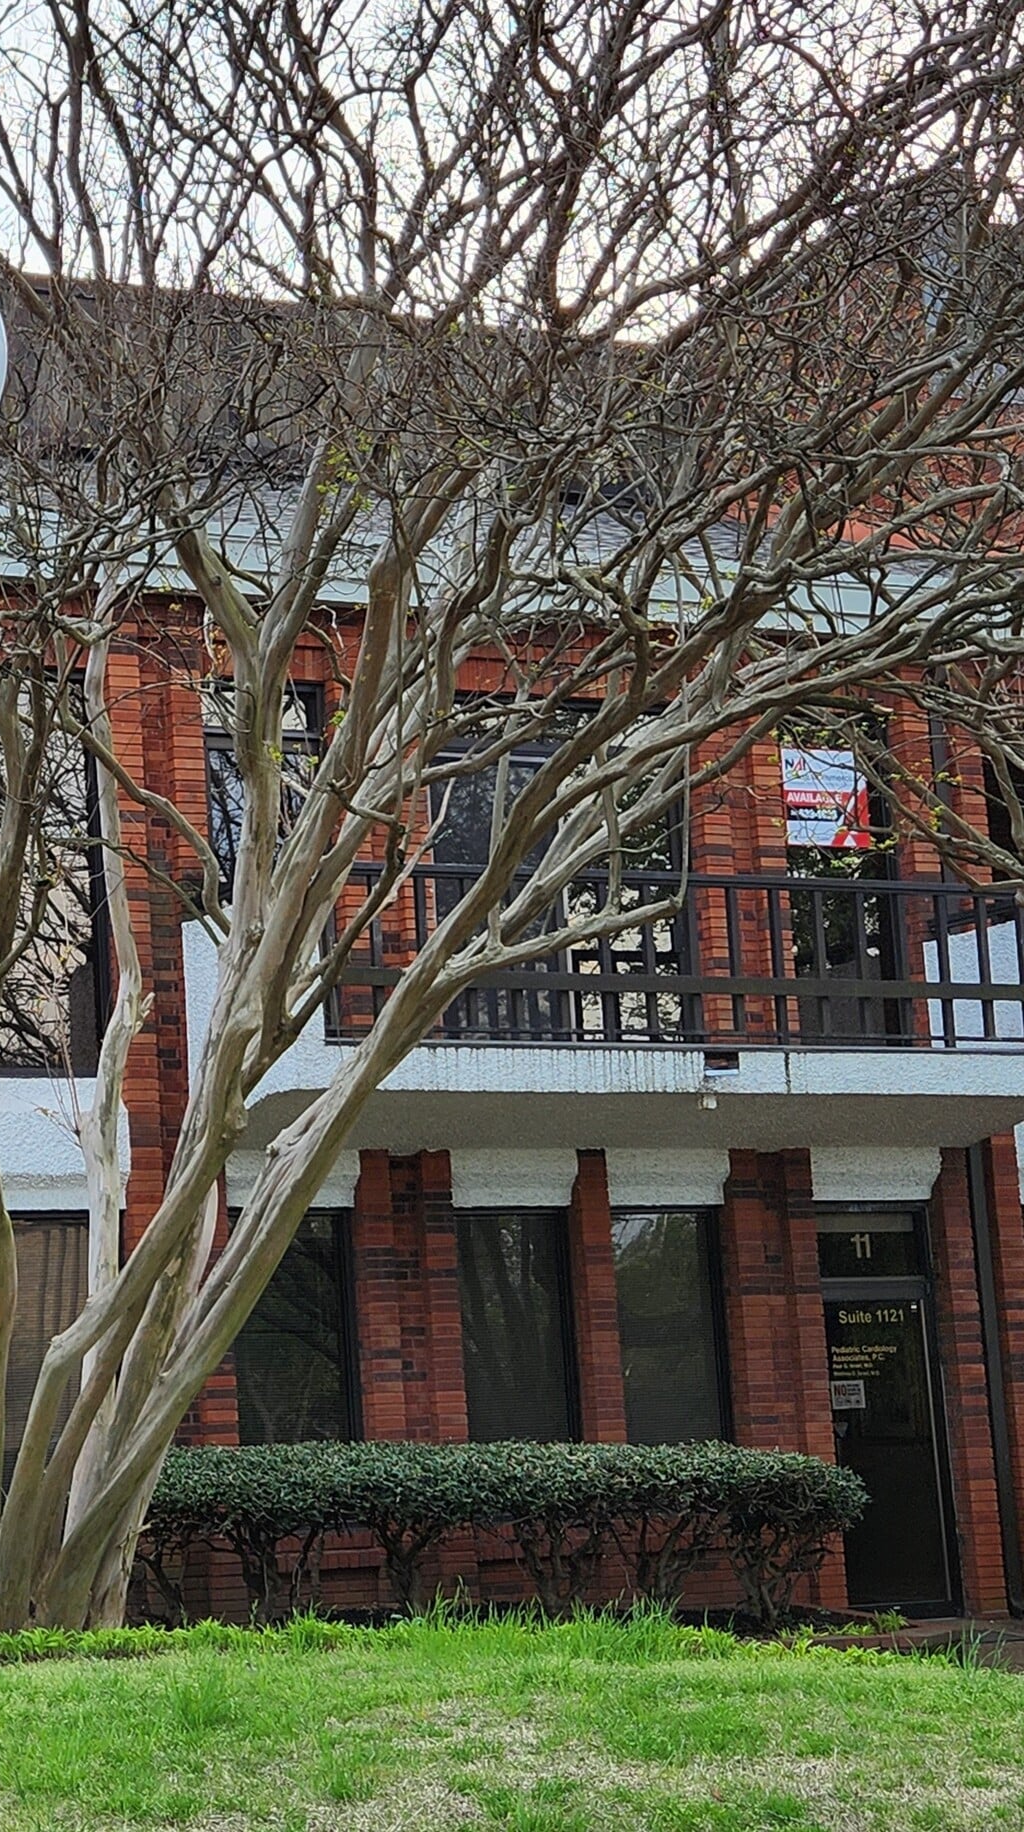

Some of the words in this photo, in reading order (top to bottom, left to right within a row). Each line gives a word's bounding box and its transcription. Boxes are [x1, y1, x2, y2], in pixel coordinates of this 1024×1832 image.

[851, 1234, 871, 1258] 11
[838, 1310, 872, 1324] Suite
[876, 1309, 905, 1323] 1121
[831, 1345, 861, 1354] Pediatric
[861, 1345, 897, 1354] Cardiology
[834, 1383, 847, 1397] NO
